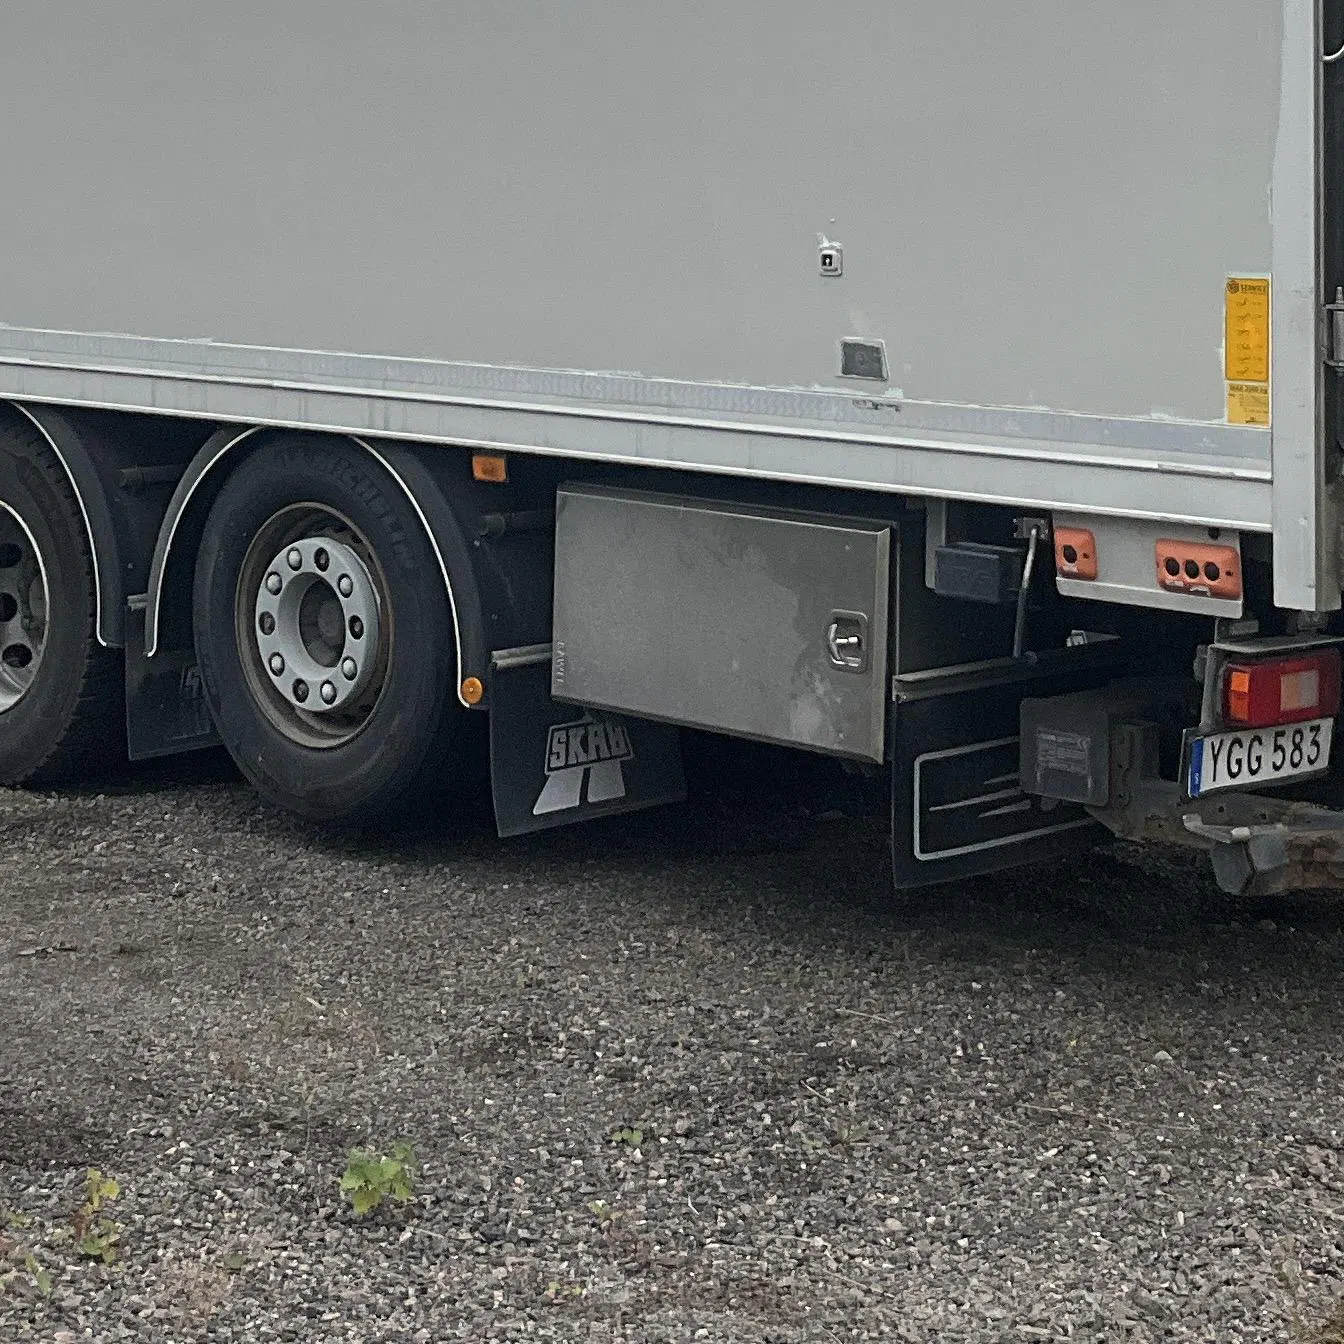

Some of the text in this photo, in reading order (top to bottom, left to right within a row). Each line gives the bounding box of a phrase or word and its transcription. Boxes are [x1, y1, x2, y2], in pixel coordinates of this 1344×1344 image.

[549, 721, 630, 769] SKAB
[1210, 723, 1321, 782] YGG 583
